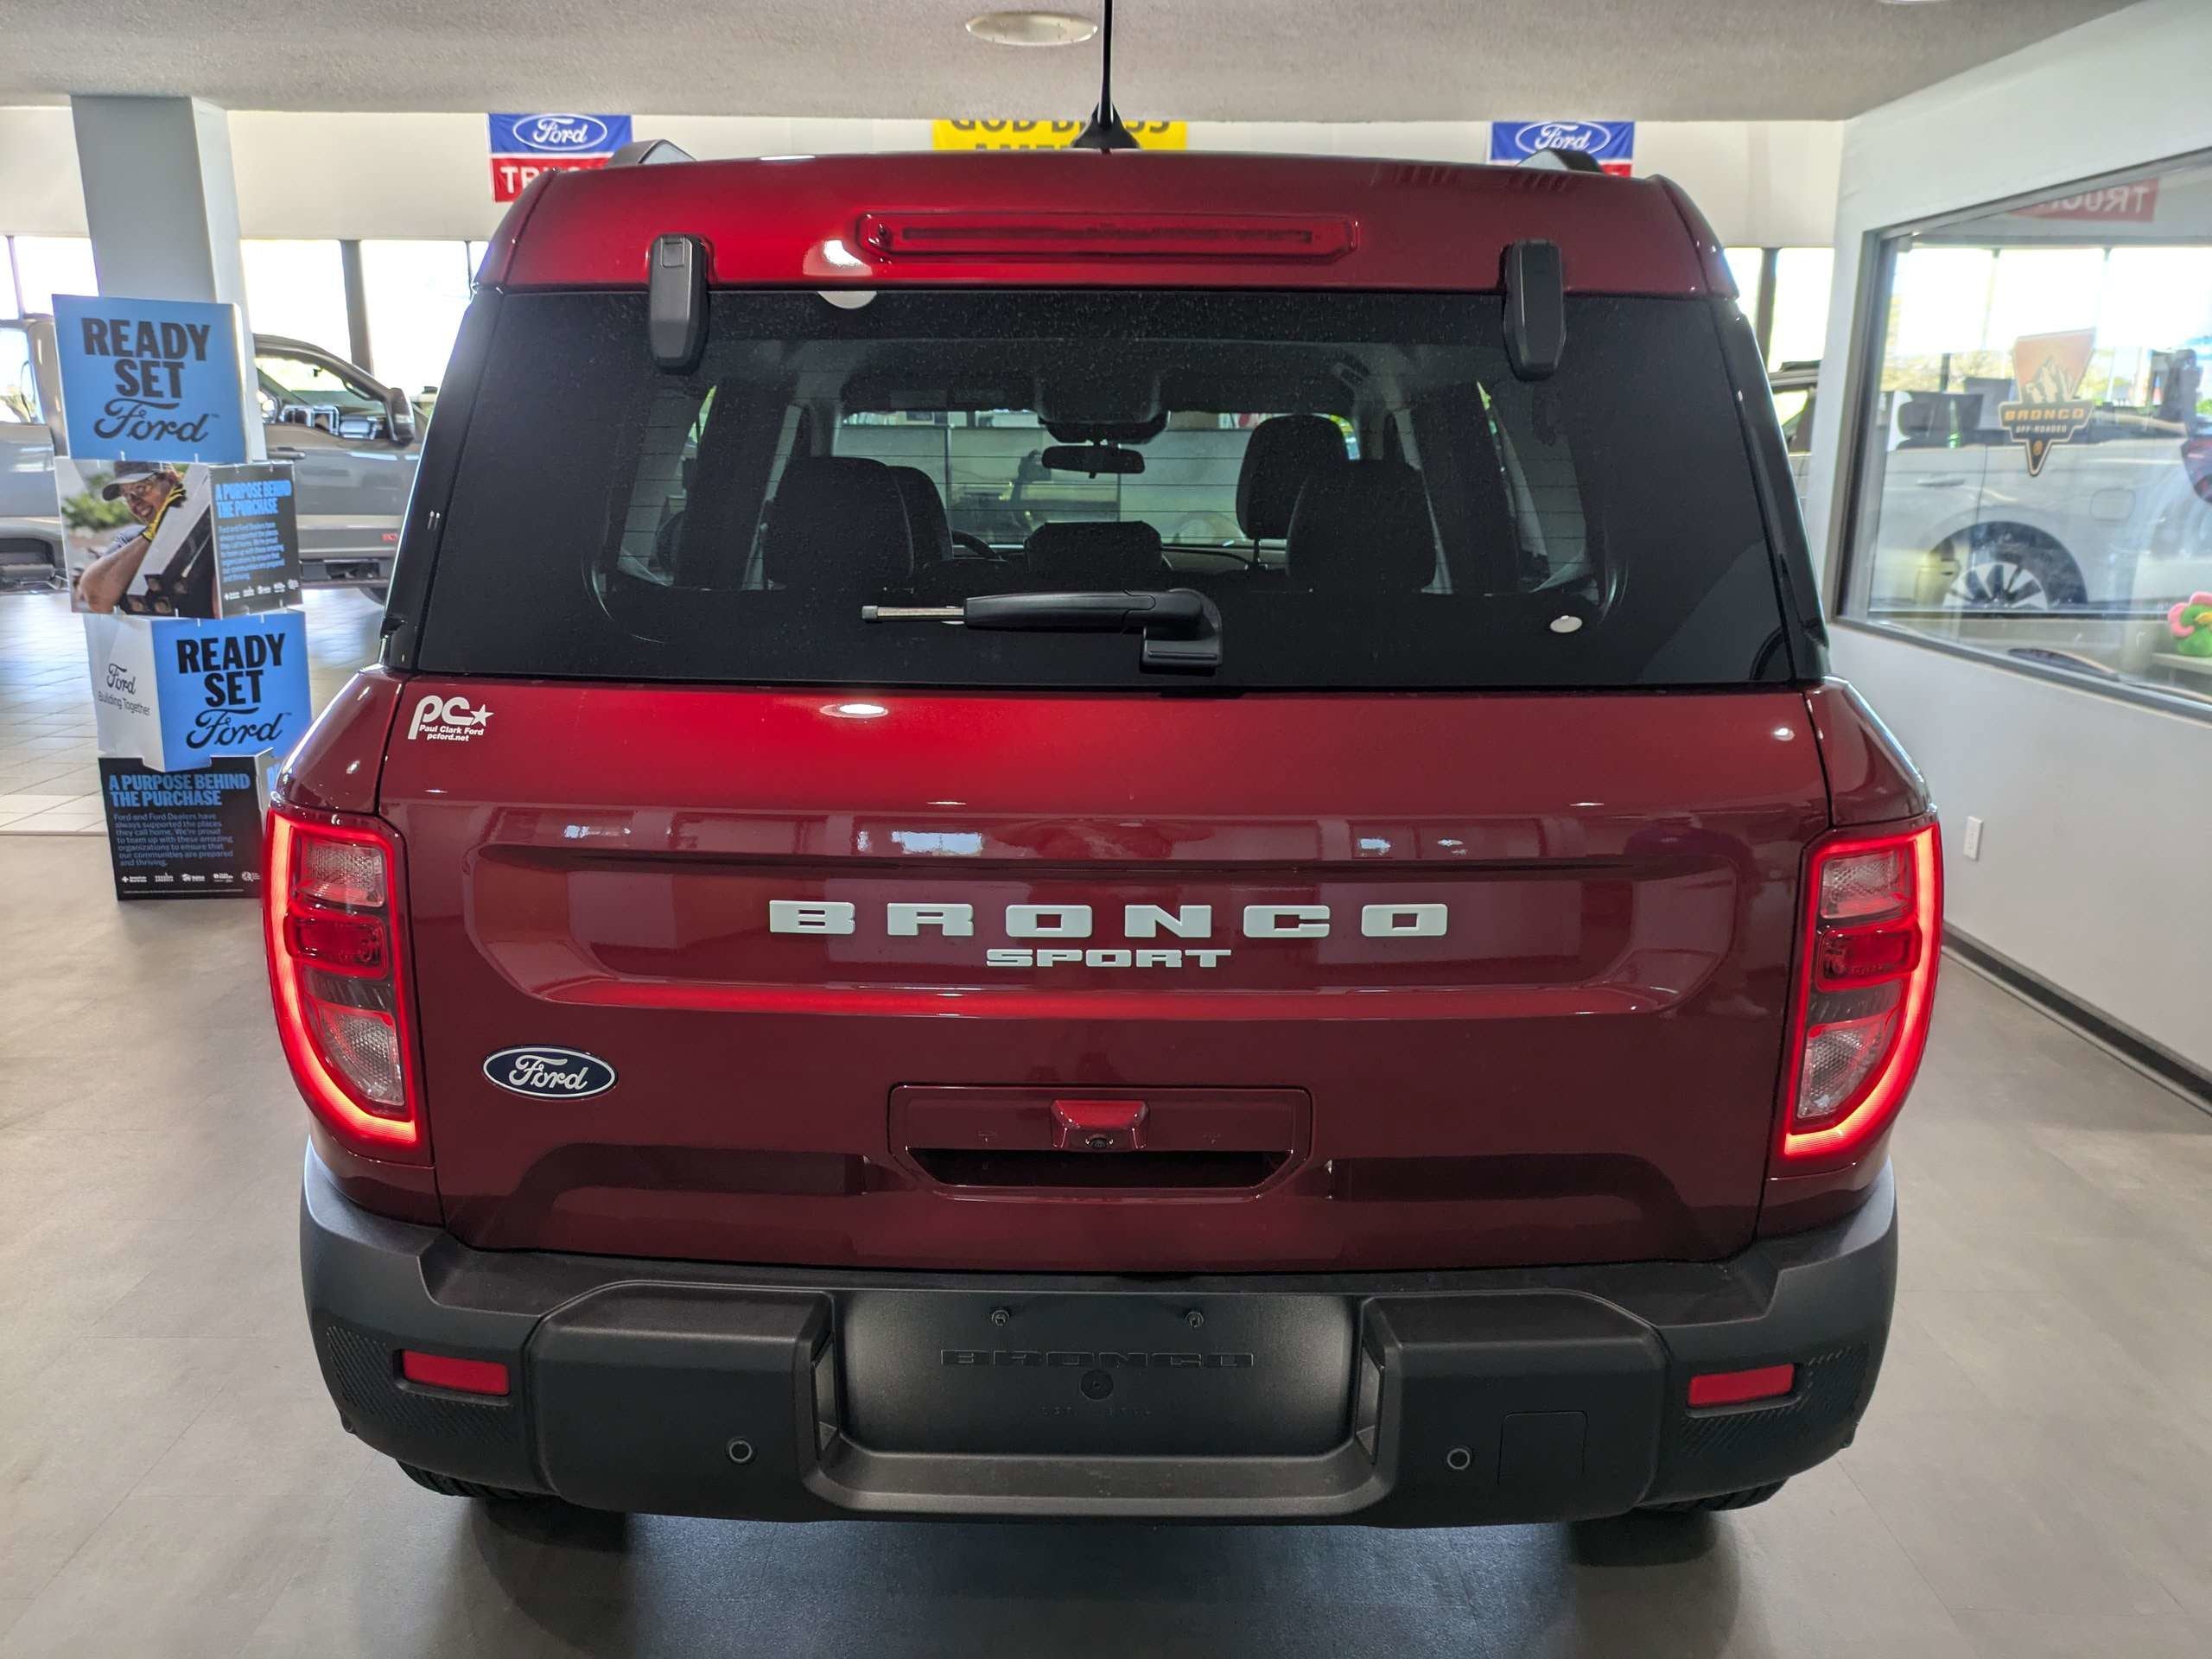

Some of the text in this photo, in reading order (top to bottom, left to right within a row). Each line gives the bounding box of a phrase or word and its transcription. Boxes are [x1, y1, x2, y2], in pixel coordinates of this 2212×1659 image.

[532, 118, 588, 144] Ford
[1535, 122, 1592, 150] Ford
[81, 317, 211, 361] READY
[113, 358, 186, 399] SET
[93, 397, 210, 442] Ford
[2005, 408, 2085, 422] BRONCO
[176, 633, 286, 674] READY
[106, 663, 137, 696] Ford
[204, 670, 264, 709] SET
[186, 707, 284, 749] Ford
[419, 724, 485, 736] Paul Clark Ford
[427, 732, 470, 742] pcford.net
[109, 774, 120, 791] A
[123, 773, 193, 791] PURPOSE
[194, 772, 251, 790] BEHIND
[111, 790, 222, 808] THE PURCHASE
[769, 899, 1448, 939] BRONCO
[986, 948, 1233, 969] SPORT
[509, 1054, 589, 1090] Ford
[940, 1349, 1255, 1369] BRONCO
